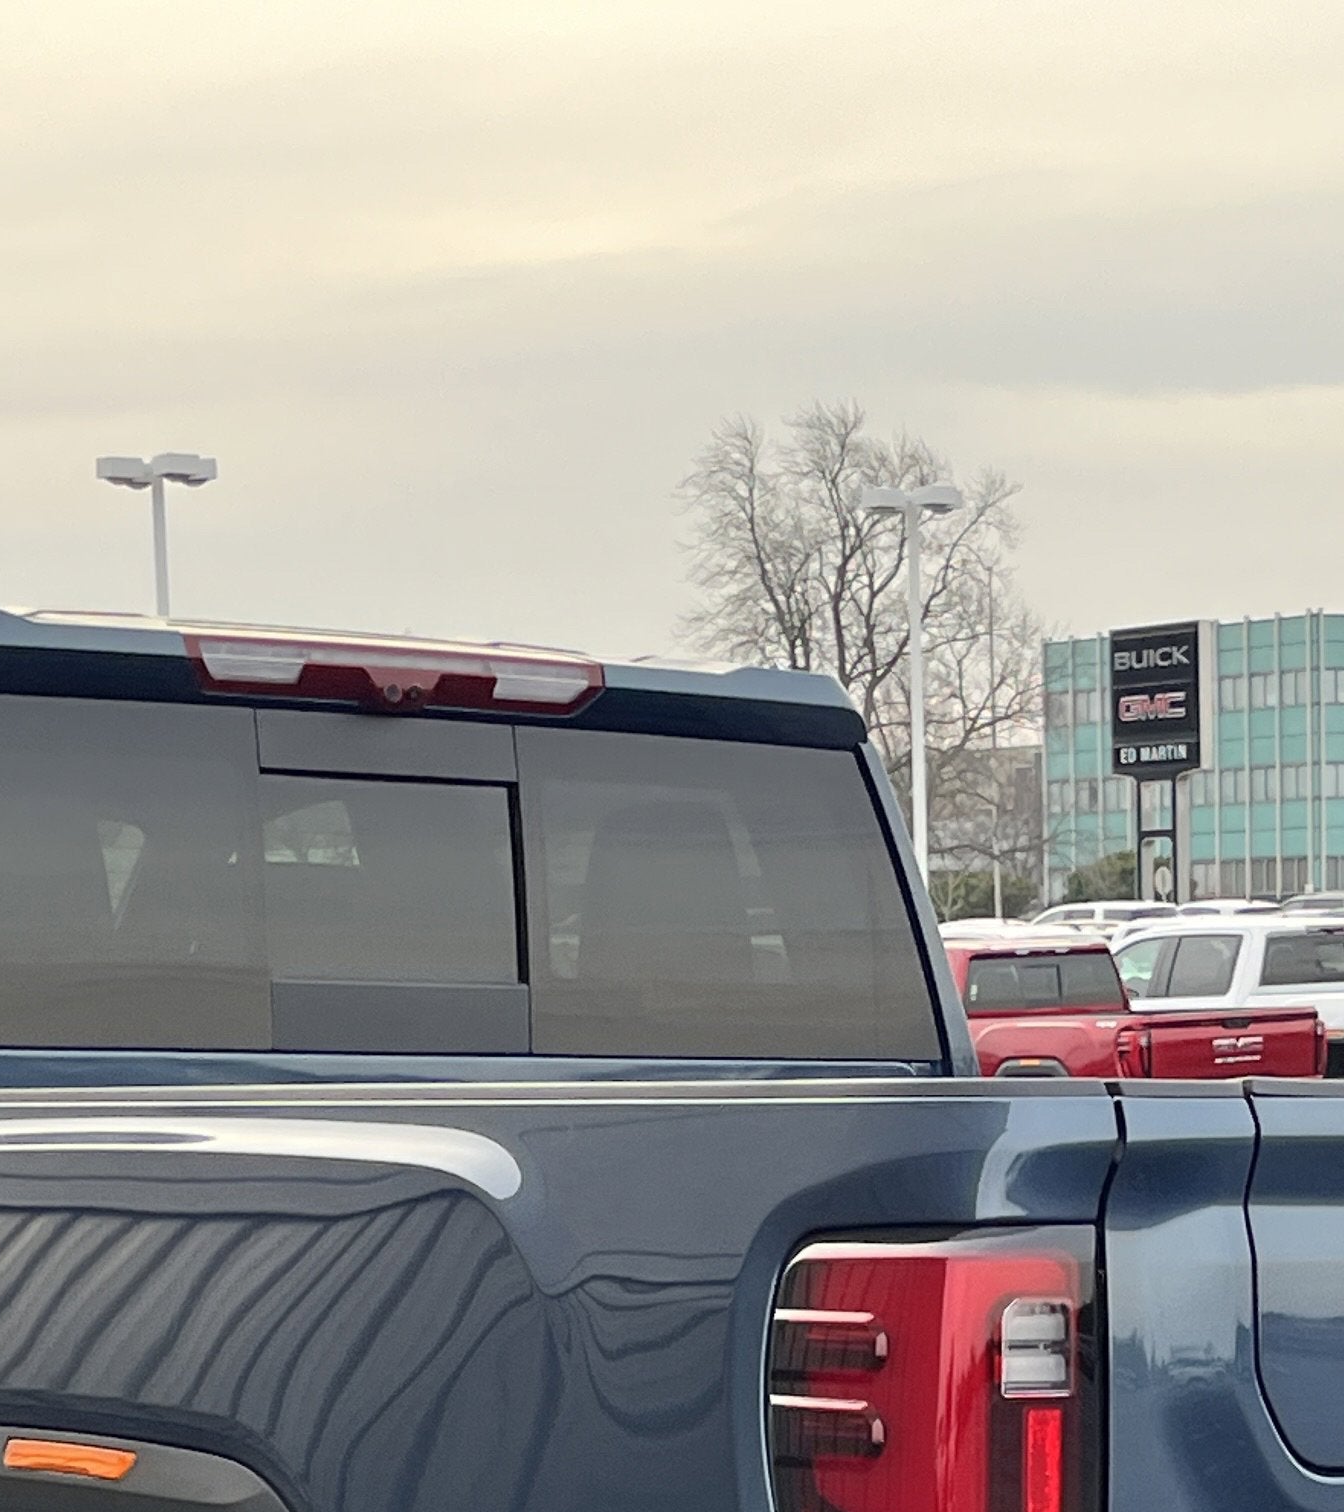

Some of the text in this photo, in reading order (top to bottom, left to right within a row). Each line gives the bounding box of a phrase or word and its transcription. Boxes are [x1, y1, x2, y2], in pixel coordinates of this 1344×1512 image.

[1113, 645, 1190, 671] BUICK
[1119, 692, 1187, 722] GMC
[1120, 744, 1187, 764] ED MARTIN
